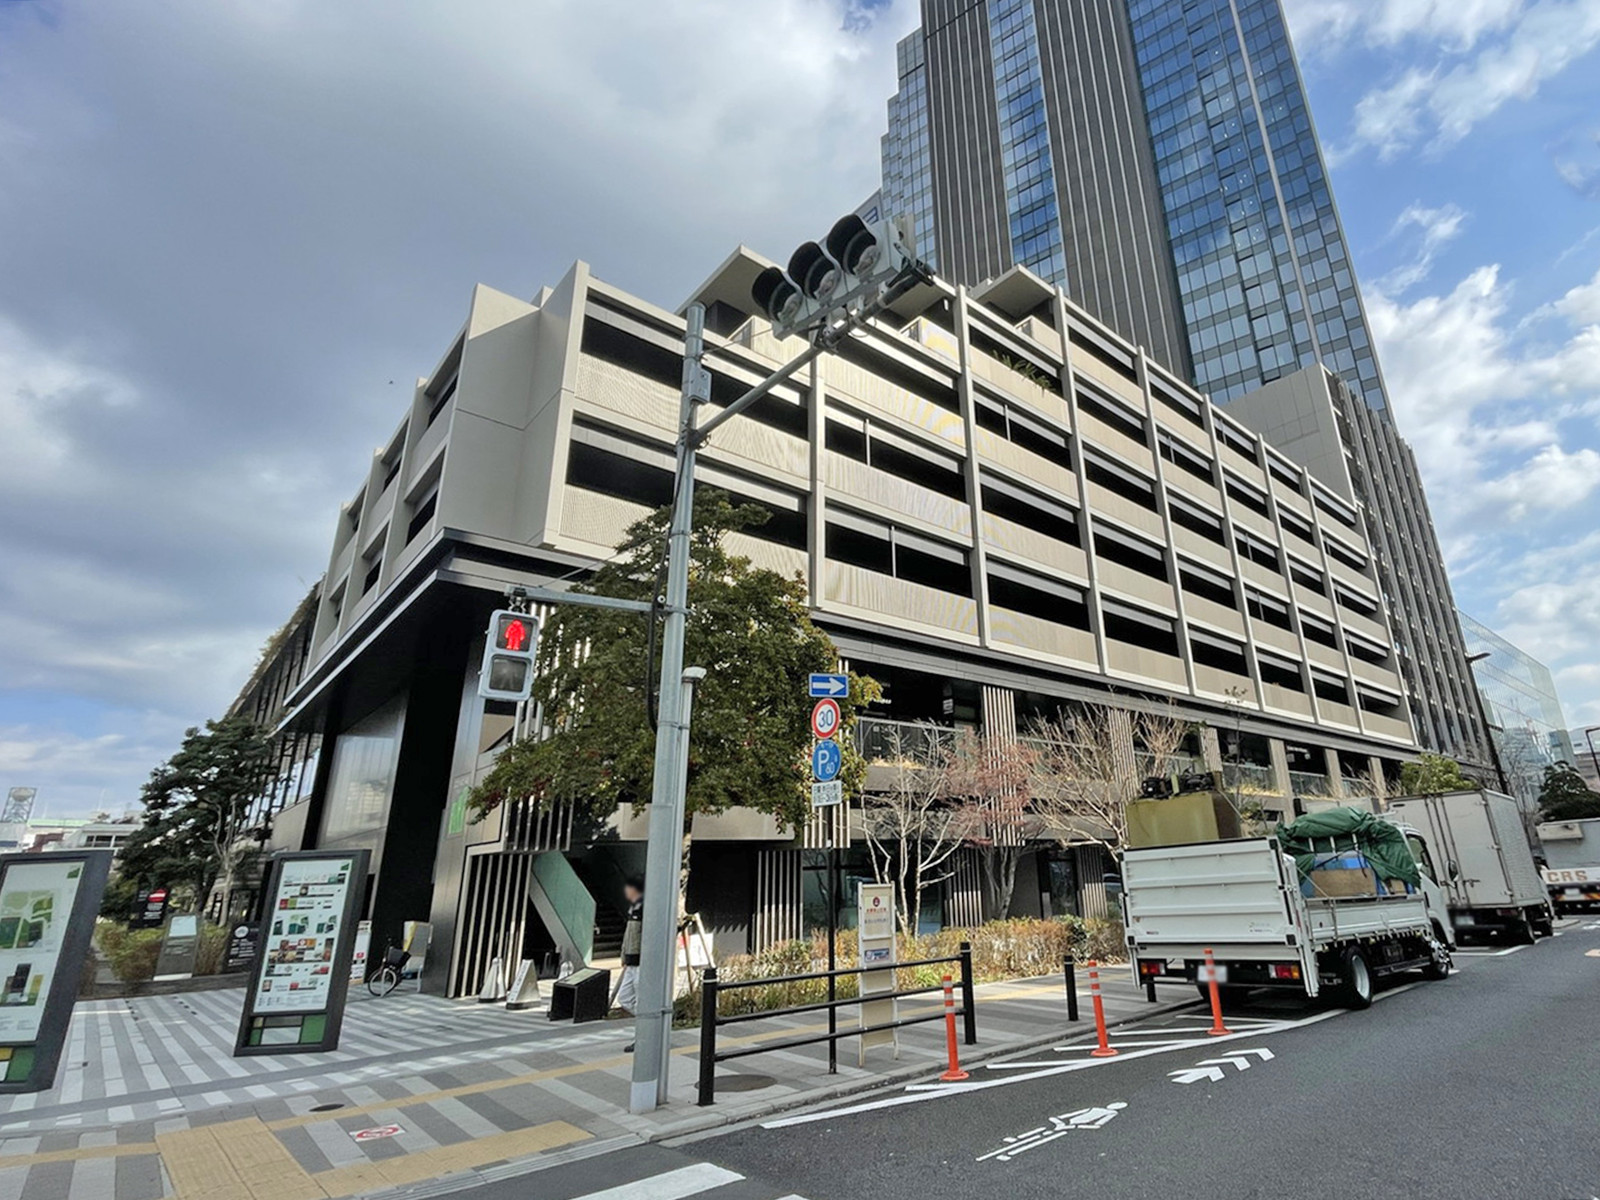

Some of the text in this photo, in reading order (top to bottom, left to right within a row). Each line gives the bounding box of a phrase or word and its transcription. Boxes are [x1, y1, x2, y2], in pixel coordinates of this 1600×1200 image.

[818, 709, 834, 728] 30
[818, 749, 830, 775] P
[1547, 870, 1588, 882] CRS
